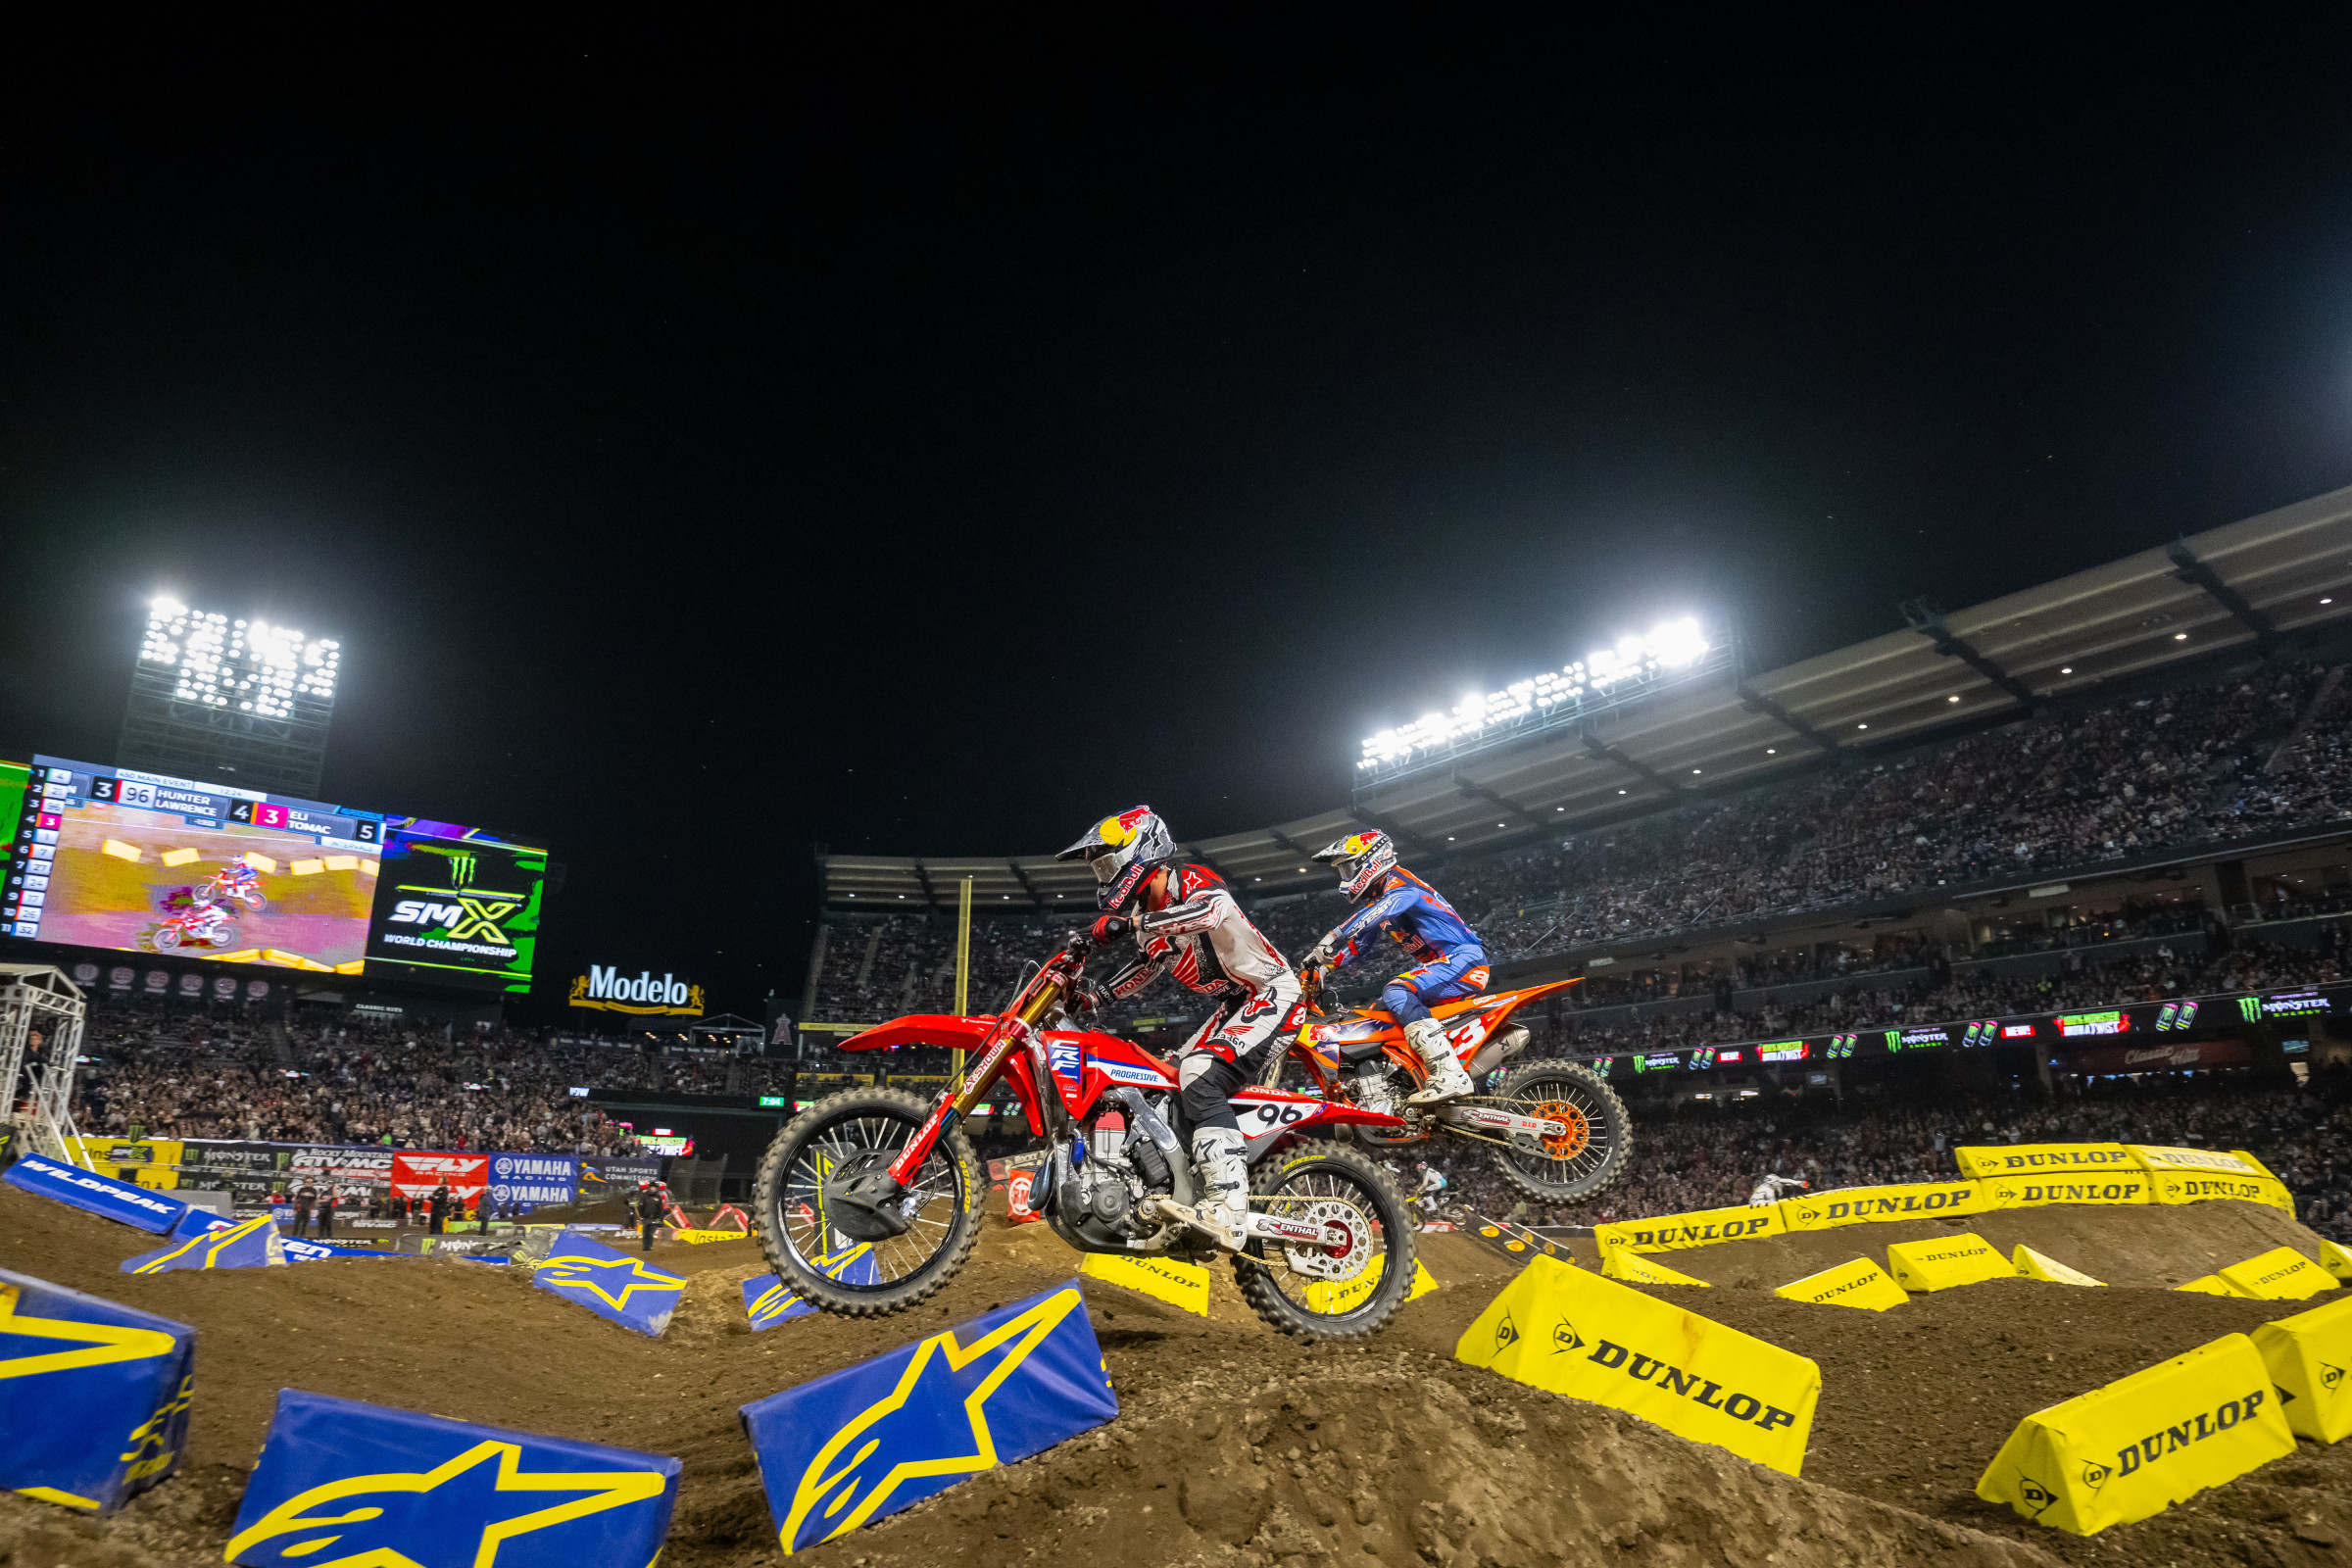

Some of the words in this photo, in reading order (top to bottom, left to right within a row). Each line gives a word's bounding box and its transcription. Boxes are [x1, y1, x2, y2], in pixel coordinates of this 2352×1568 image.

[138, 774, 162, 783] MAIN
[164, 777, 192, 787] EVENT
[95, 782, 114, 798] 3
[126, 787, 149, 804] 96
[157, 789, 211, 805] HUNTER
[28, 800, 39, 808] 3
[155, 799, 218, 816] LAWRENCE
[233, 805, 249, 819] 4
[264, 808, 279, 824] 3
[290, 810, 309, 821] ELI
[22, 830, 32, 839] 5
[288, 820, 331, 834] TOMAC
[359, 825, 373, 840] 5
[330, 841, 373, 853] INTERVALS
[11, 876, 23, 885] 8
[8, 892, 19, 901] 9
[3, 907, 16, 916] 10
[1, 923, 12, 932] 11
[20, 926, 32, 935] 32
[388, 898, 515, 944] SMX
[384, 934, 425, 947] WORLD
[426, 939, 517, 957] CHAMPIONSHIP
[588, 964, 688, 1004] Modelo
[2262, 999, 2330, 1011] MONSTER
[1901, 1033, 1948, 1044] MONSTER
[975, 1040, 1004, 1078] SHOWA
[1110, 1068, 1158, 1082] PROGRESSIVE
[1257, 1103, 1302, 1130] 96
[894, 1113, 939, 1170] DUNLOP
[399, 1156, 486, 1172] FLY
[514, 1159, 570, 1176] YAMAHA
[1282, 1154, 1326, 1172] DUNLOP
[2004, 1152, 2127, 1168] DUNLOP
[629, 1166, 658, 1175] SPORTS
[22, 1159, 176, 1214] WILDPEAK
[512, 1186, 568, 1202] YAMAHA
[958, 1158, 972, 1214] DUNLOP
[2022, 1184, 2140, 1201] DUNLOP
[2185, 1181, 2260, 1199] DUNLOP
[1826, 1189, 1971, 1220] DUNLOP
[1633, 1217, 1769, 1247] DUNLOP
[1927, 1248, 1988, 1261] DUNLOP
[2259, 1261, 2306, 1285] DUNLOP
[1813, 1272, 1879, 1303] DUNLOP
[1587, 1339, 1795, 1433] DUNLOP
[2117, 1390, 2265, 1478] DUNLOP
